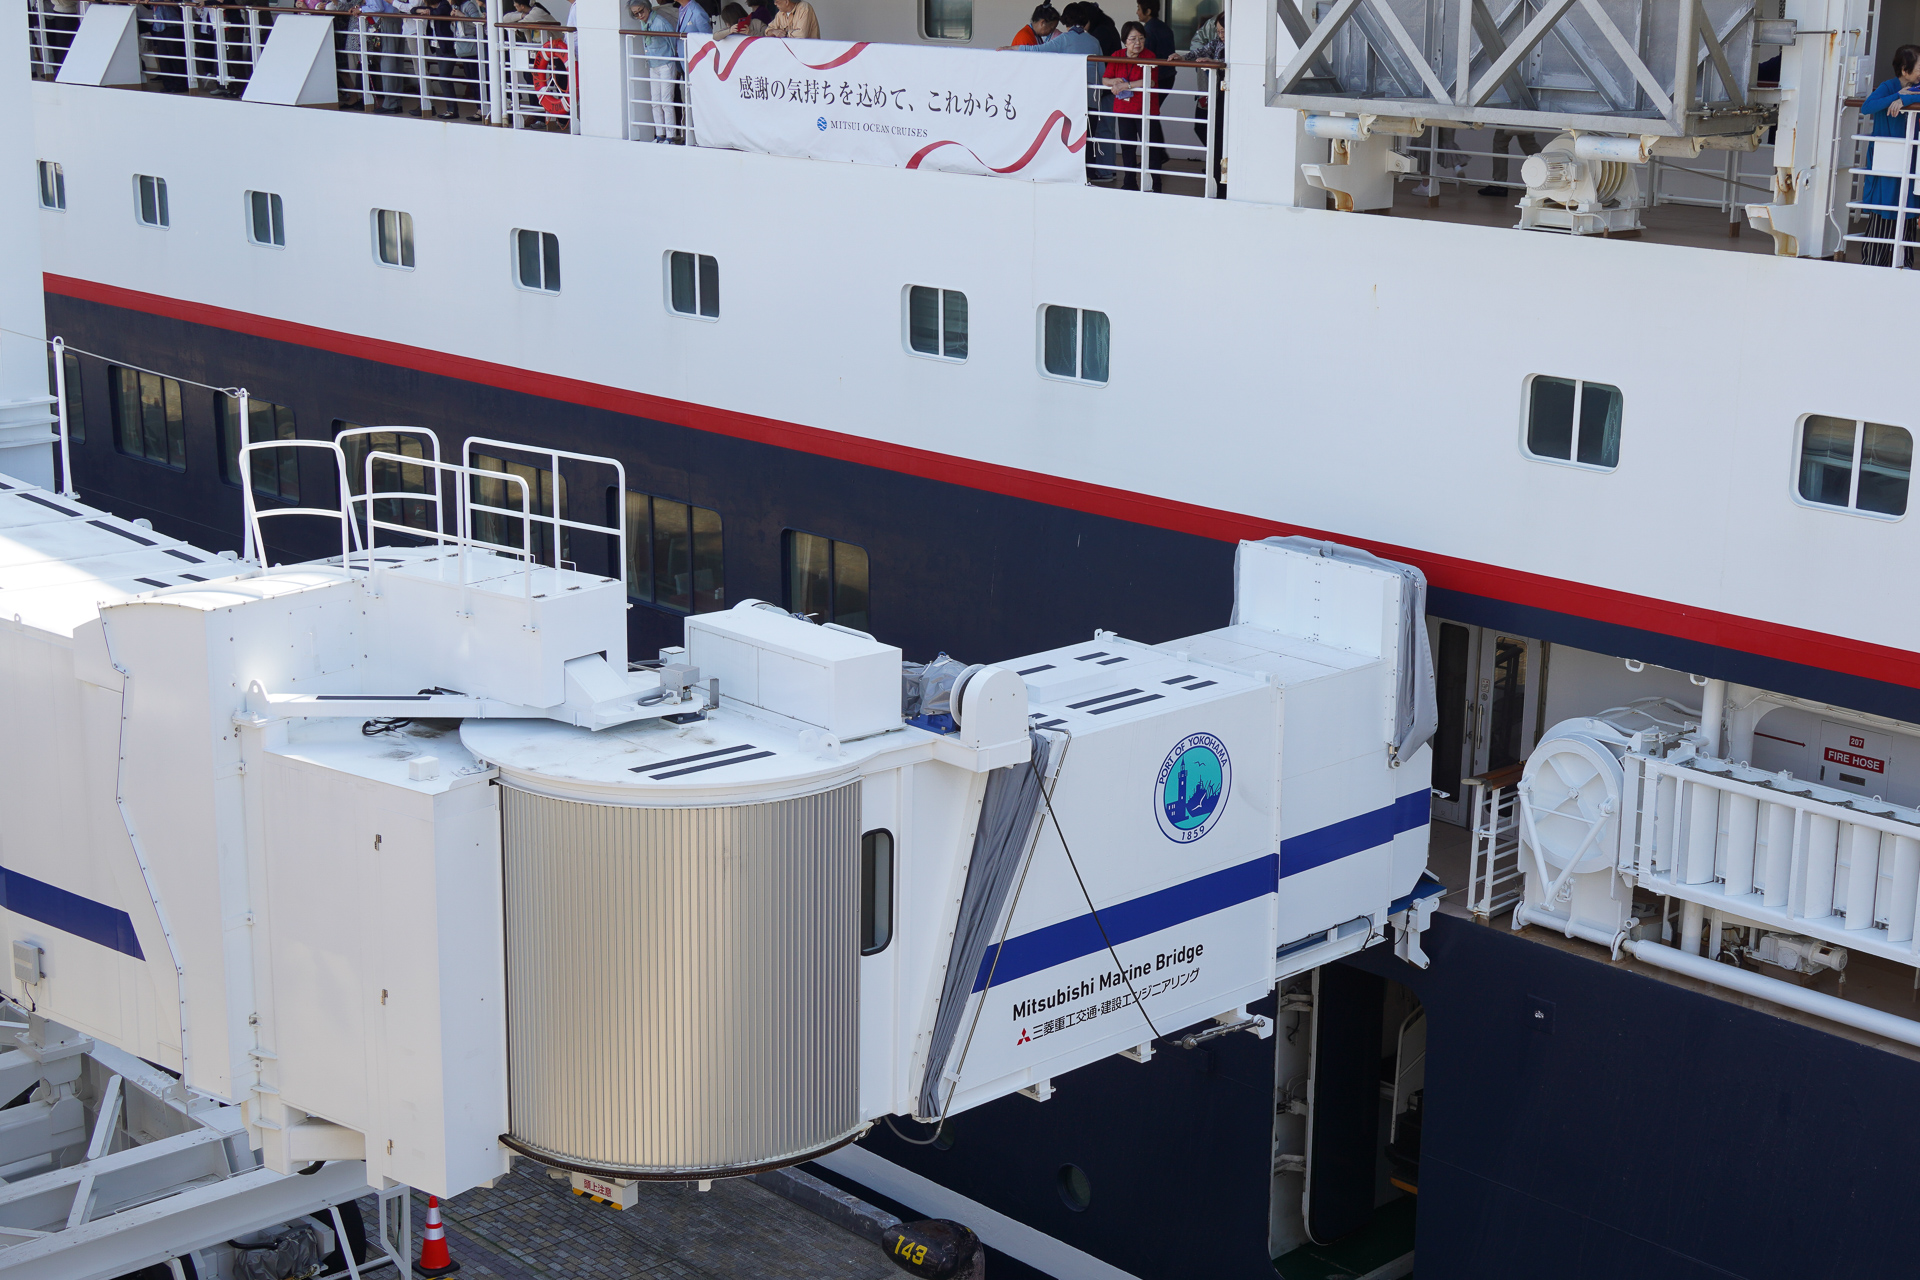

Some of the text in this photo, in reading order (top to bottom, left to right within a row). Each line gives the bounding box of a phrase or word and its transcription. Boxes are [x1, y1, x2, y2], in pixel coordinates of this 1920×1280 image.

[739, 75, 1016, 120] 感謝の気持ちを込めて、これからも
[830, 120, 928, 138] MITSUI OCEAN CRUISES
[1850, 738, 1863, 747] 207
[1159, 735, 1228, 784] PORT OF YOKOHAMA
[1828, 750, 1880, 770] FIRE HOSE
[1182, 825, 1205, 840] 1859
[1013, 943, 1204, 1021] Mitsubishi Marine Bridge
[1032, 968, 1200, 1040] 三菱重工交通・建設エンジニアリング
[583, 1178, 612, 1198] 頭上注意
[894, 1234, 928, 1265] 143
